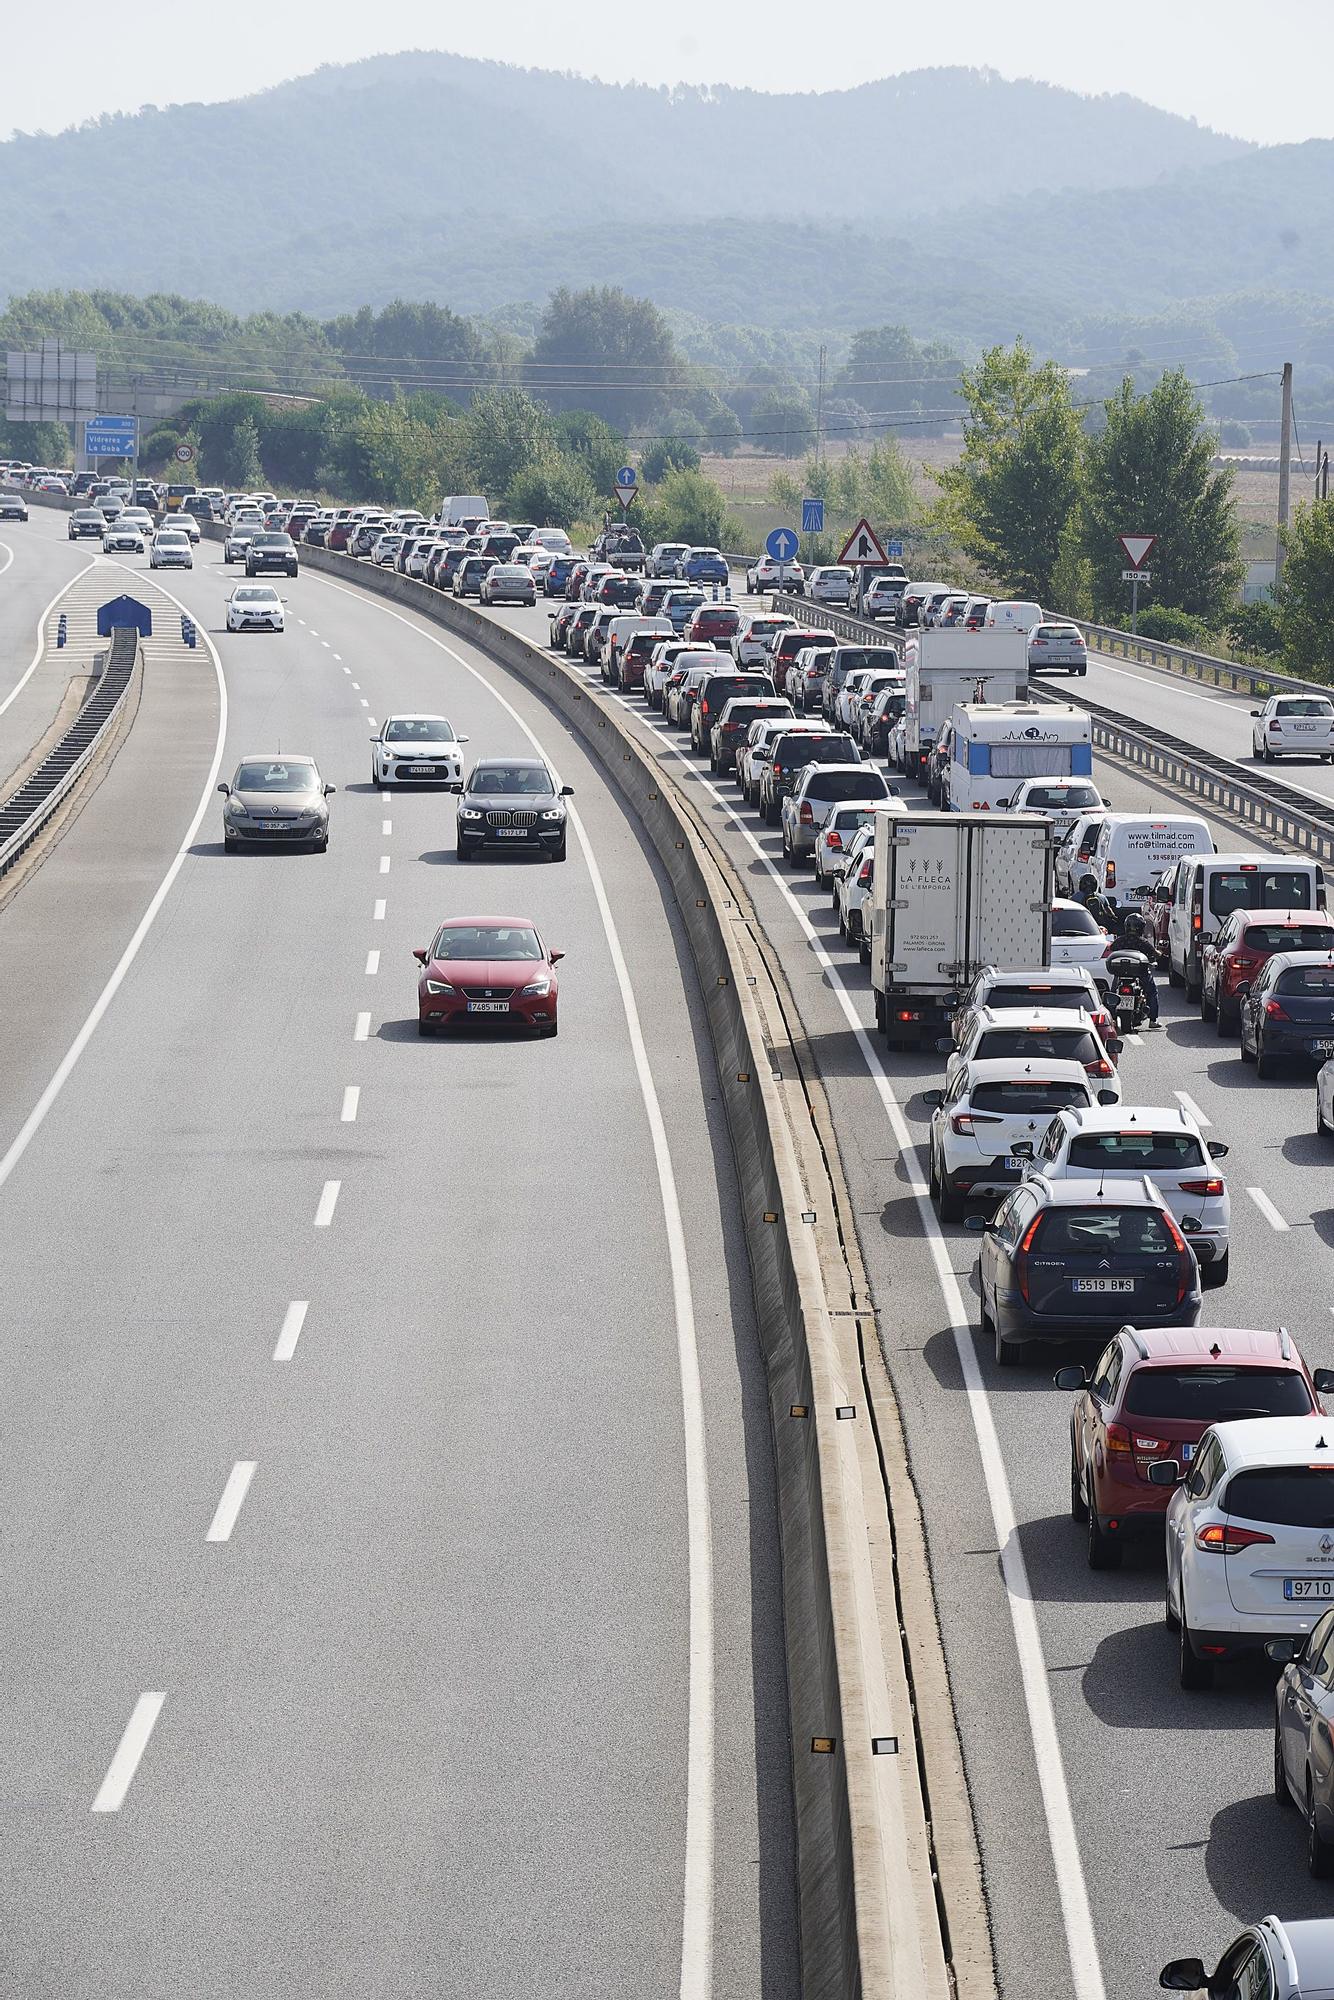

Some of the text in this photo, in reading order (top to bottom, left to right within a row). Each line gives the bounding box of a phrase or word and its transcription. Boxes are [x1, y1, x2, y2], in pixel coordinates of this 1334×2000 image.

[1127, 832, 1195, 840] www.tilmad.com
[1127, 841, 1195, 849] info@tilmad.com
[918, 875, 951, 883] FLECA
[472, 1003, 491, 1011] 7485
[1079, 1280, 1132, 1291] 5519 BWS
[1294, 1582, 1331, 1595] 9710
